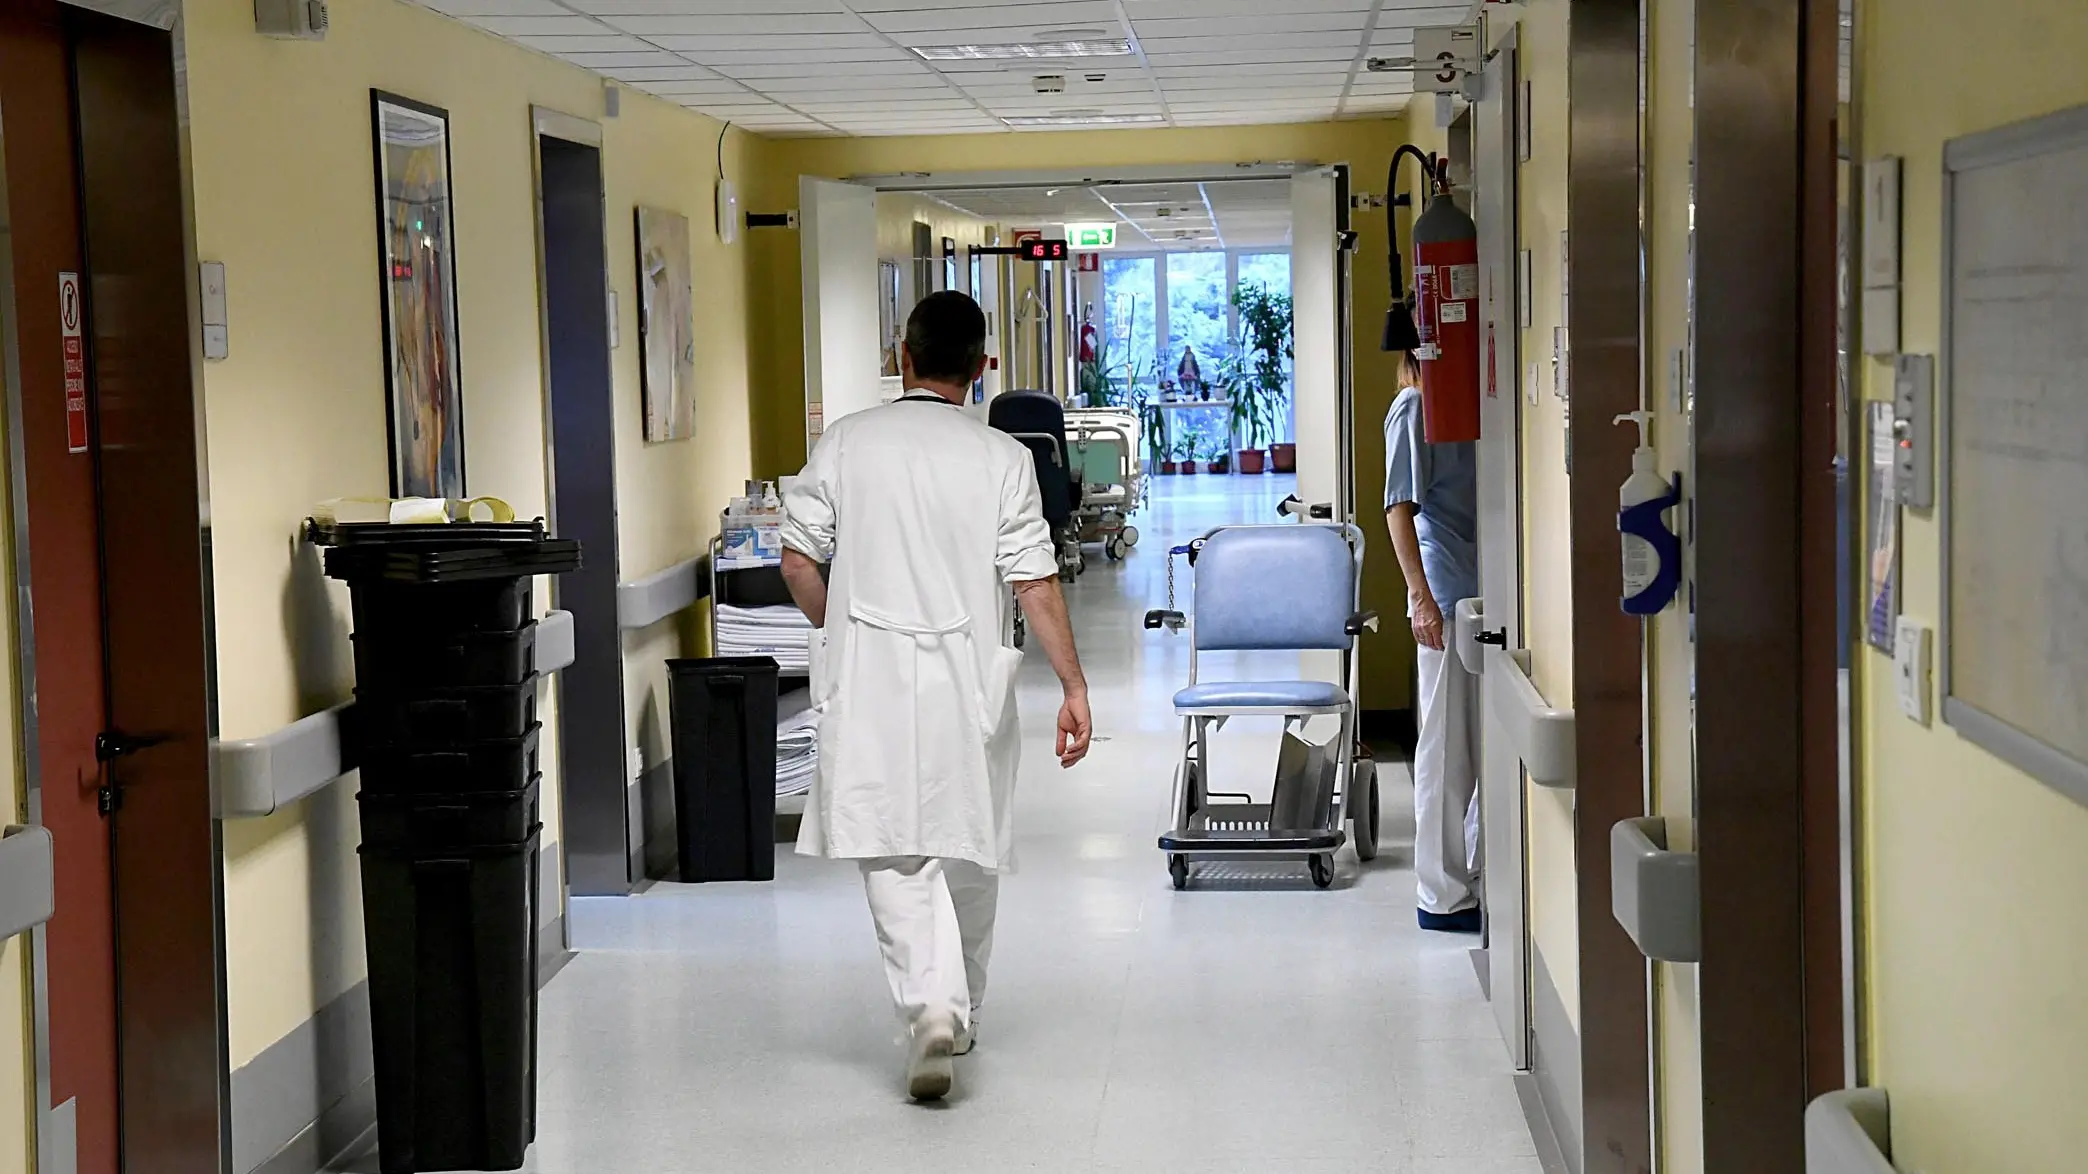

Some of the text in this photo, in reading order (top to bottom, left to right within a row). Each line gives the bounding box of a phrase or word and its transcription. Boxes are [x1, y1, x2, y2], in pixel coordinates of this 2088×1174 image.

[1436, 51, 1456, 83] 3
[1033, 245, 1060, 256] 16 5
